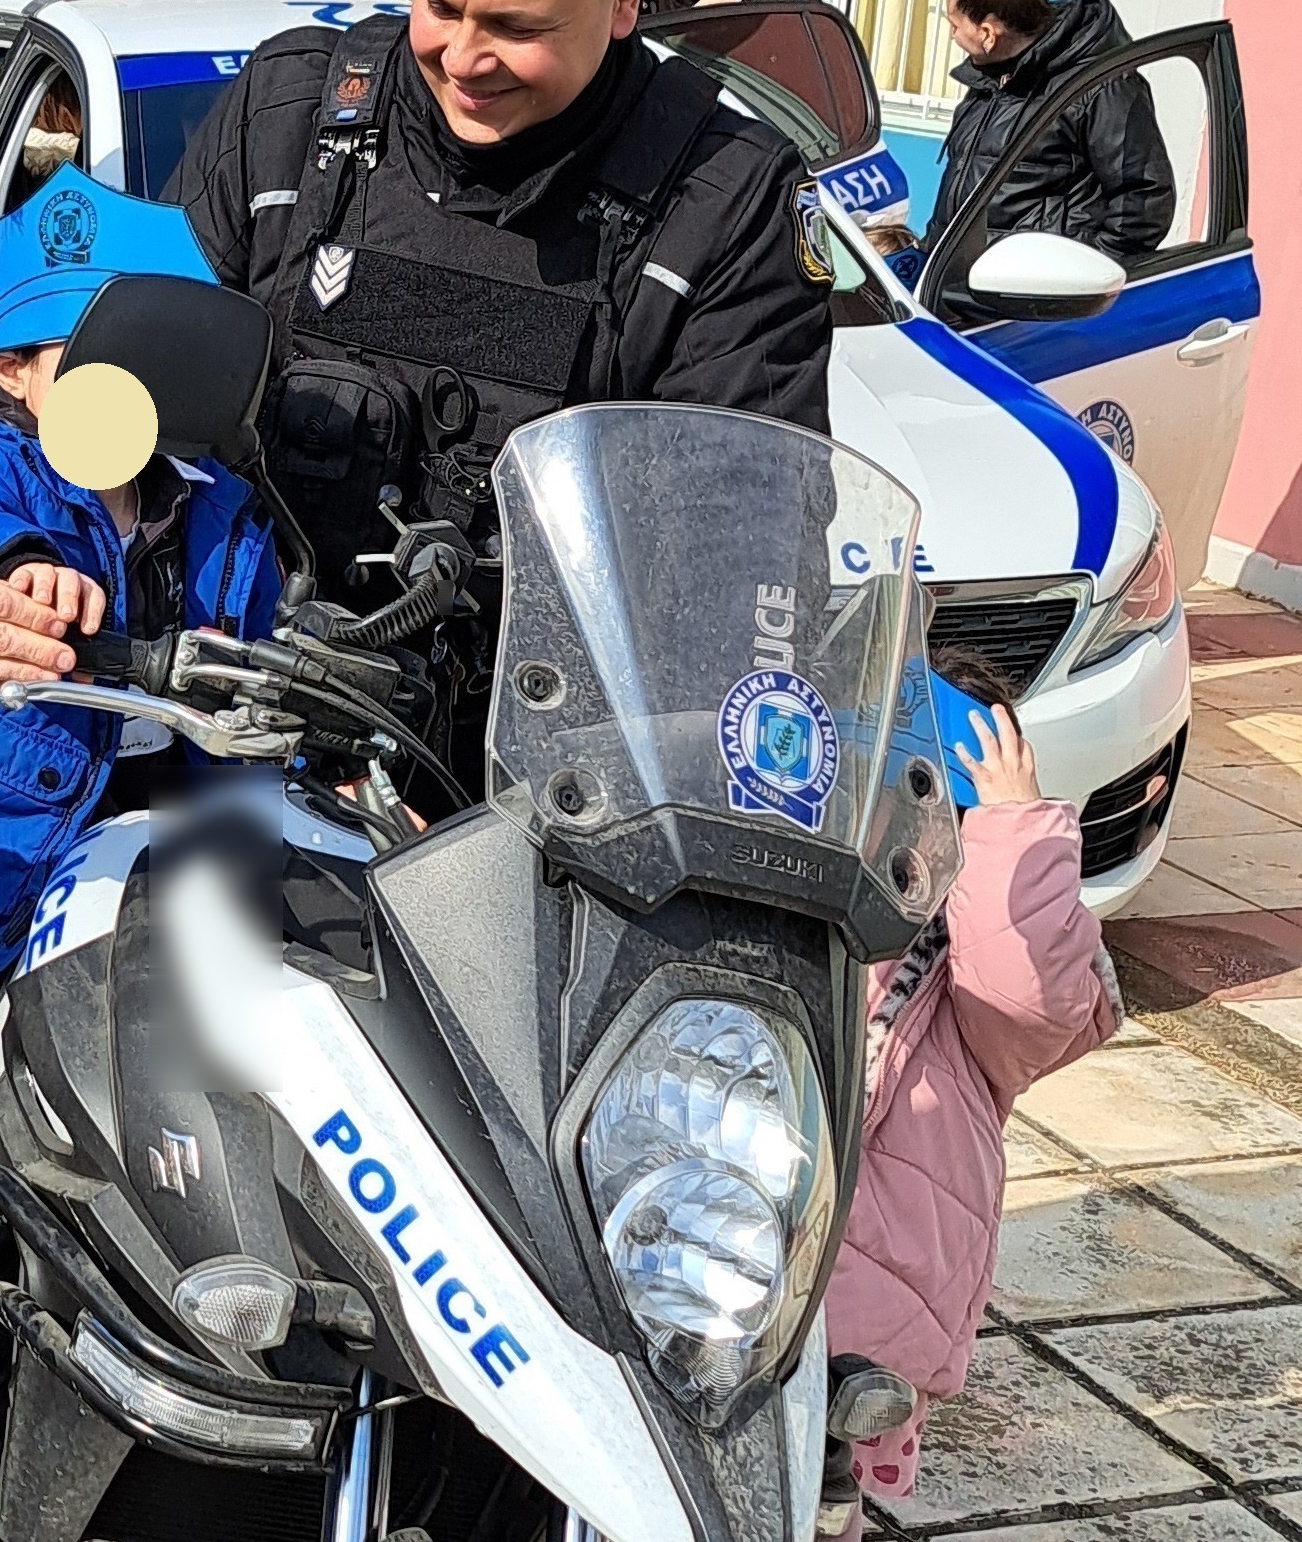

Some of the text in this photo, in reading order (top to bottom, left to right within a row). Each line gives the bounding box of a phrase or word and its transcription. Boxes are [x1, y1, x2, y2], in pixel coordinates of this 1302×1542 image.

[829, 163, 892, 210] ΑΣΗ
[1097, 402, 1133, 465] ΑΣΤΥΝΟ
[753, 583, 796, 671] LICE
[723, 672, 777, 770] ΕΛΛΗΝΙΚΗ
[786, 677, 837, 795] ΑΣΤΥΝΟΜΙΑ
[730, 842, 823, 883] SUZUKI
[312, 1109, 532, 1388] POLICE
